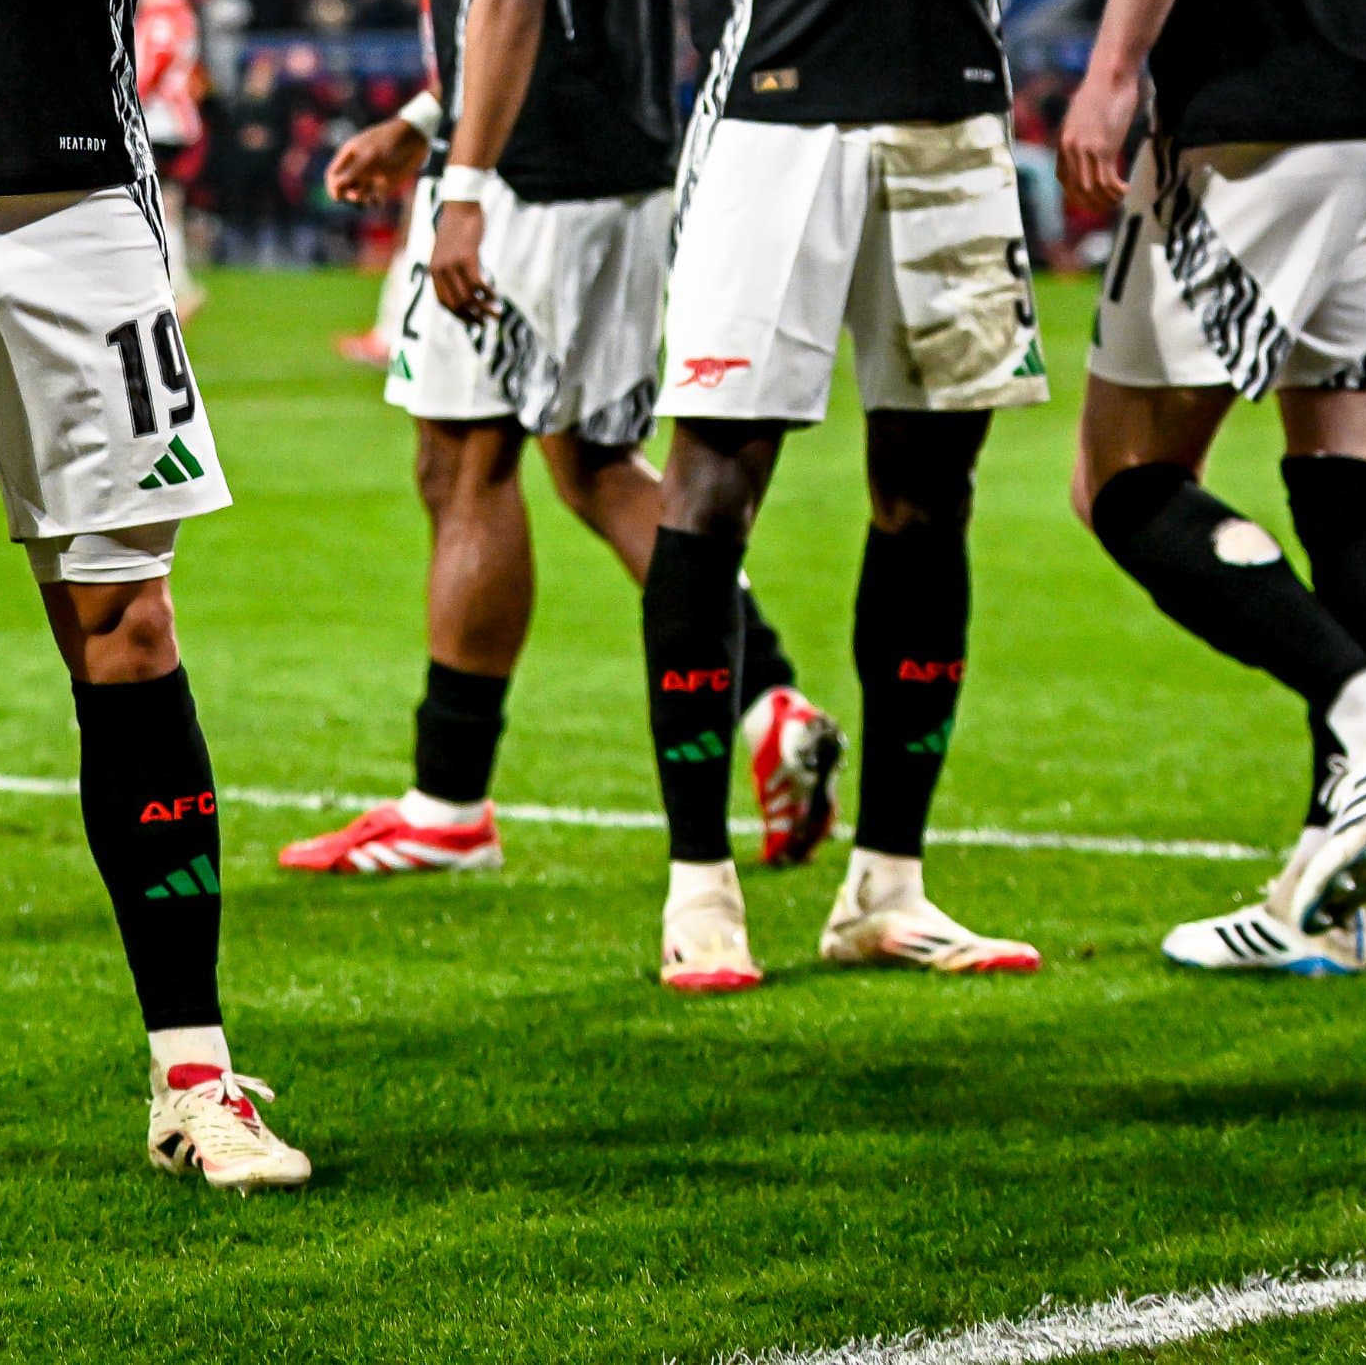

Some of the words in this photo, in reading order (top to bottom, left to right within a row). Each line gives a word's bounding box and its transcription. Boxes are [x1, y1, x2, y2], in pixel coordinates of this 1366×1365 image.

[59, 136, 107, 152] HEAT.RDY
[105, 308, 196, 439] 19
[662, 669, 729, 692] AFC
[139, 790, 215, 823] AFC
